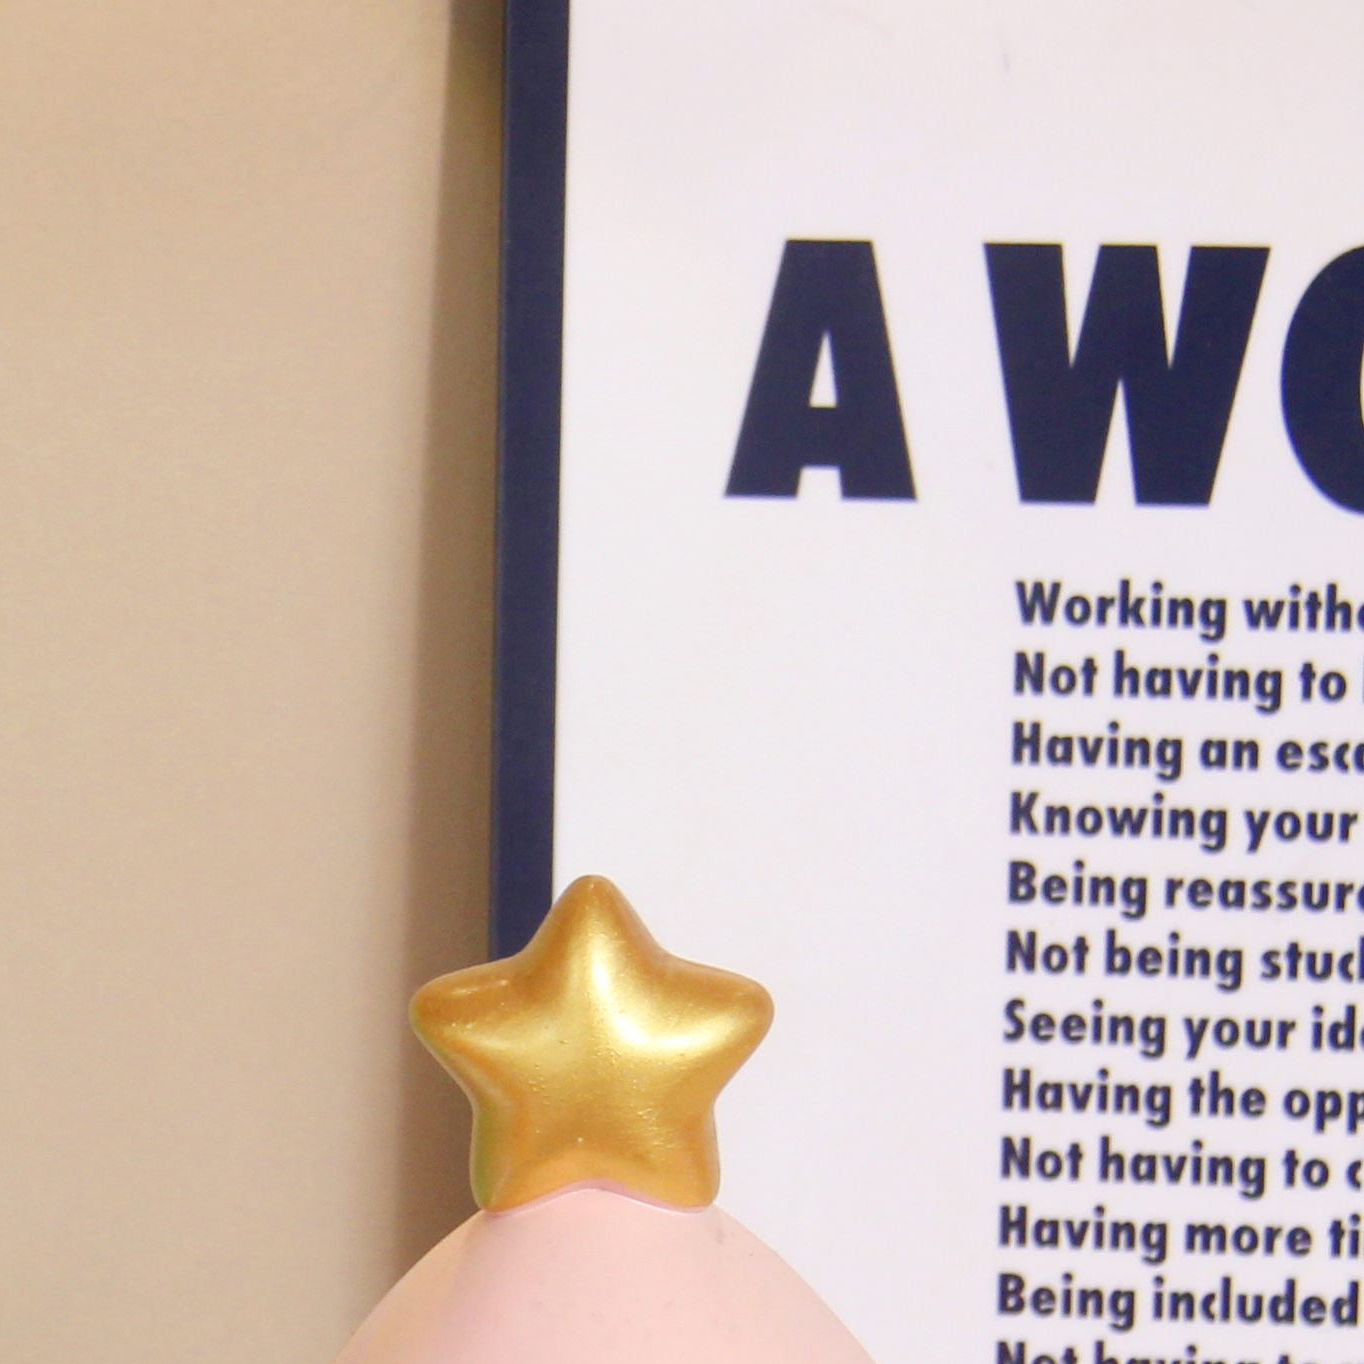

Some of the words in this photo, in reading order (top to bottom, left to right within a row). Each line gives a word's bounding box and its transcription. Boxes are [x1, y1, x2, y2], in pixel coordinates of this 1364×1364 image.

[725, 239, 917, 501] A
[1016, 579, 1226, 643] Working
[1243, 583, 1364, 631] with
[1014, 651, 1097, 696] Not
[1114, 649, 1282, 715] having
[1299, 662, 1347, 702] to
[1012, 721, 1182, 782] Having
[1200, 740, 1259, 770] an
[1010, 792, 1227, 853] Knowing
[1244, 810, 1358, 853] your
[1009, 860, 1147, 921] Being
[1165, 878, 1364, 912] reassur
[1007, 930, 1089, 974] Not
[1105, 929, 1243, 993] being
[1261, 936, 1364, 982] stuc
[1004, 998, 1166, 1059] Seeing
[1184, 1017, 1296, 1059] your
[1312, 1004, 1364, 1051] id
[1003, 1068, 1171, 1129] Having
[1189, 1070, 1266, 1118] the
[1001, 1136, 1083, 1180] Not
[1099, 1135, 1266, 1200] having
[1283, 1149, 1329, 1189] to
[1000, 1205, 1167, 1266] Having
[1185, 1224, 1312, 1257] more
[998, 1272, 1135, 1332] Being
[1153, 1275, 1359, 1327] included
